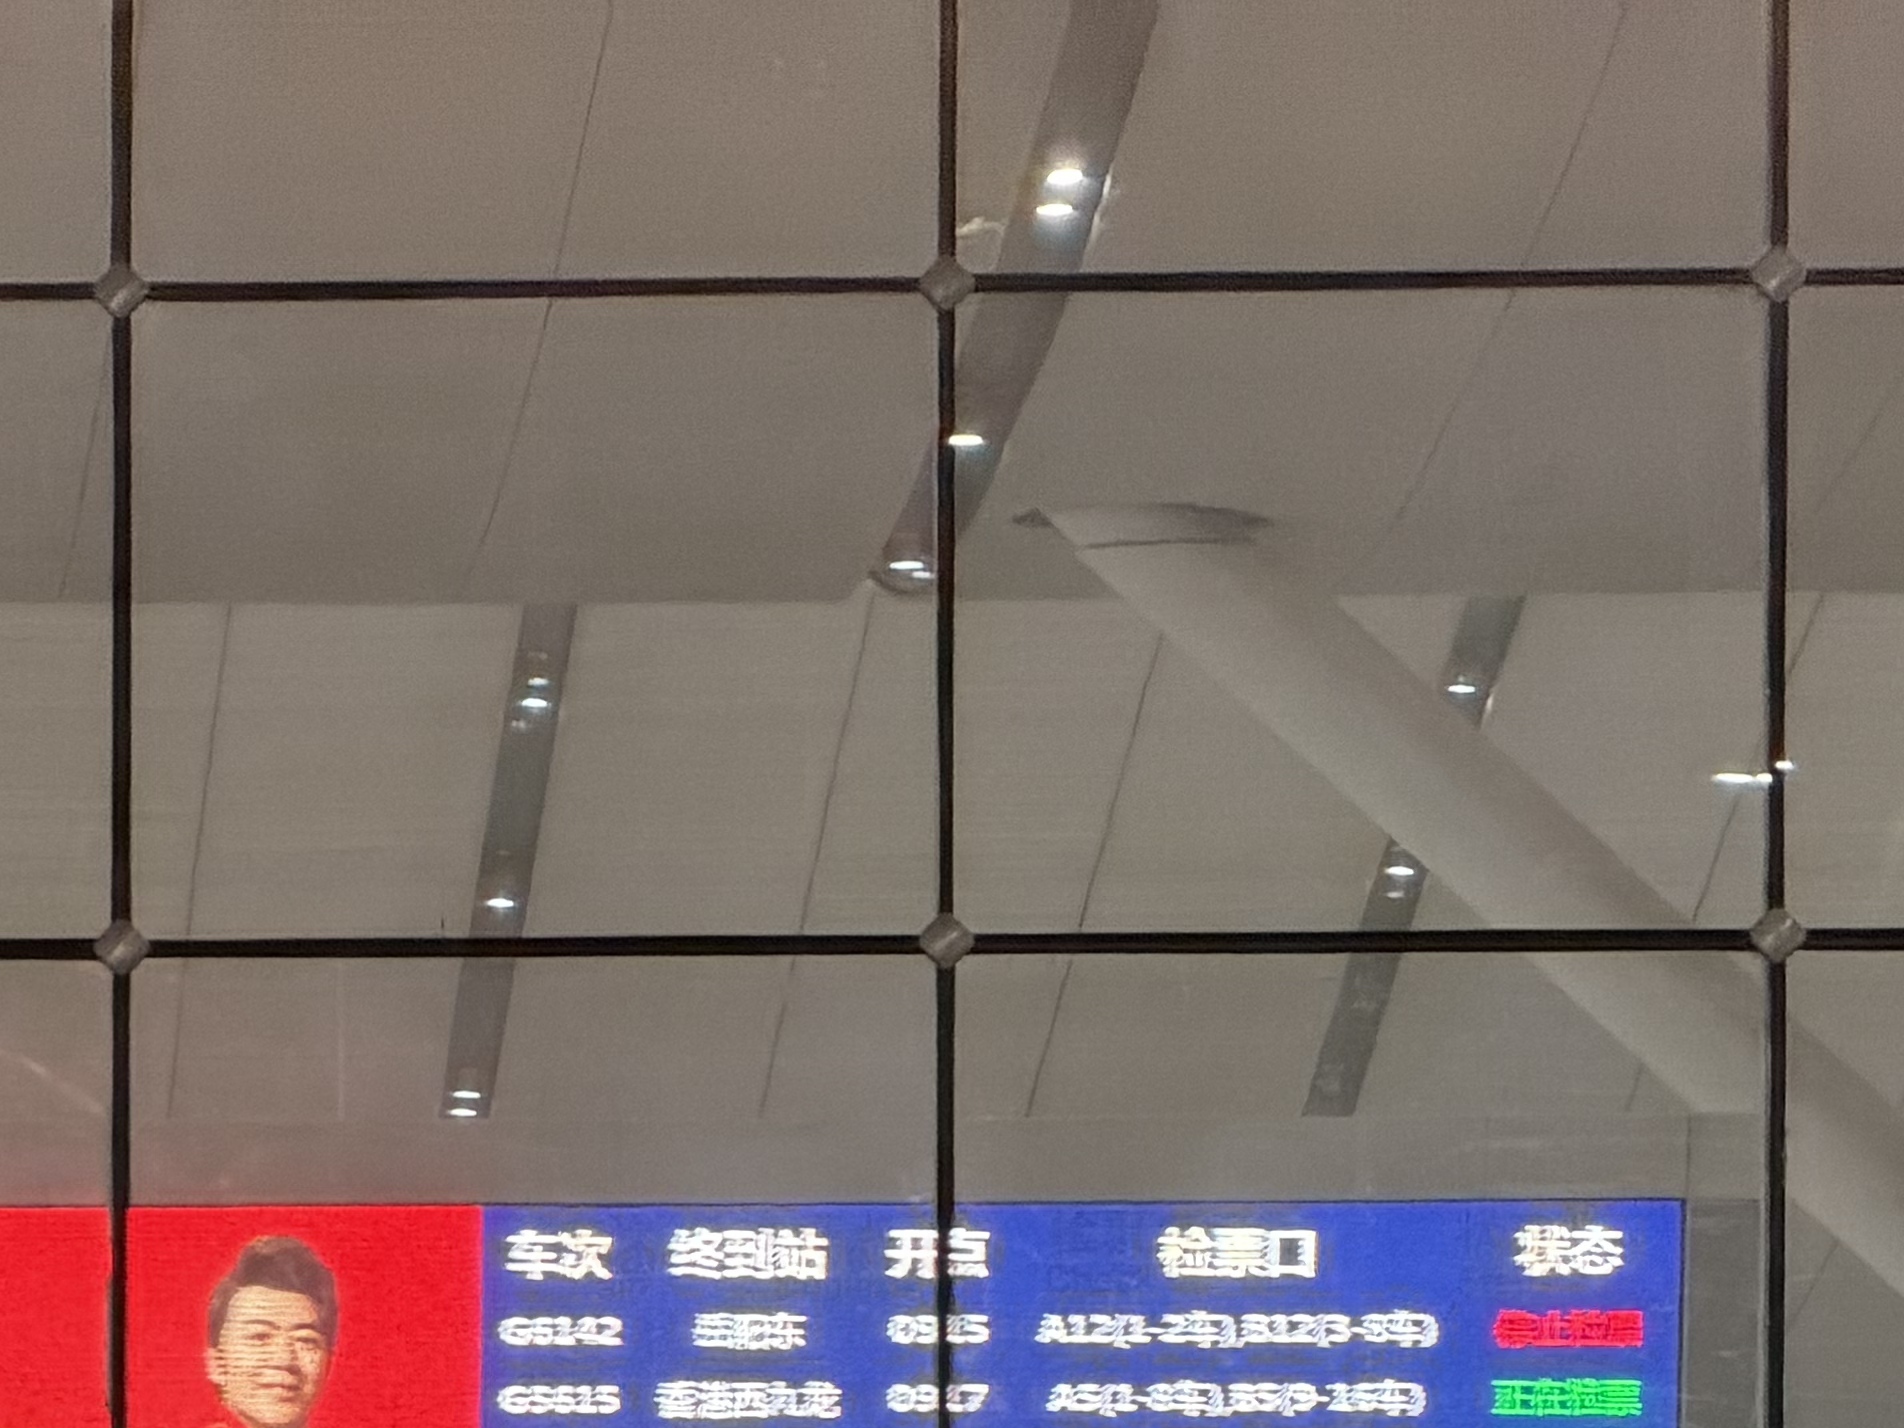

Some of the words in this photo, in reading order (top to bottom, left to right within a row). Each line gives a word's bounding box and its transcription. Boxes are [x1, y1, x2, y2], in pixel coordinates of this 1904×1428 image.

[507, 1230, 613, 1281] 车次
[669, 1228, 829, 1281] 终到站
[886, 1229, 991, 1280] 开点
[1158, 1227, 1317, 1279] 检票口
[1515, 1226, 1624, 1277] 状态
[888, 1316, 990, 1345] 0915
[888, 1385, 990, 1413] 0917
